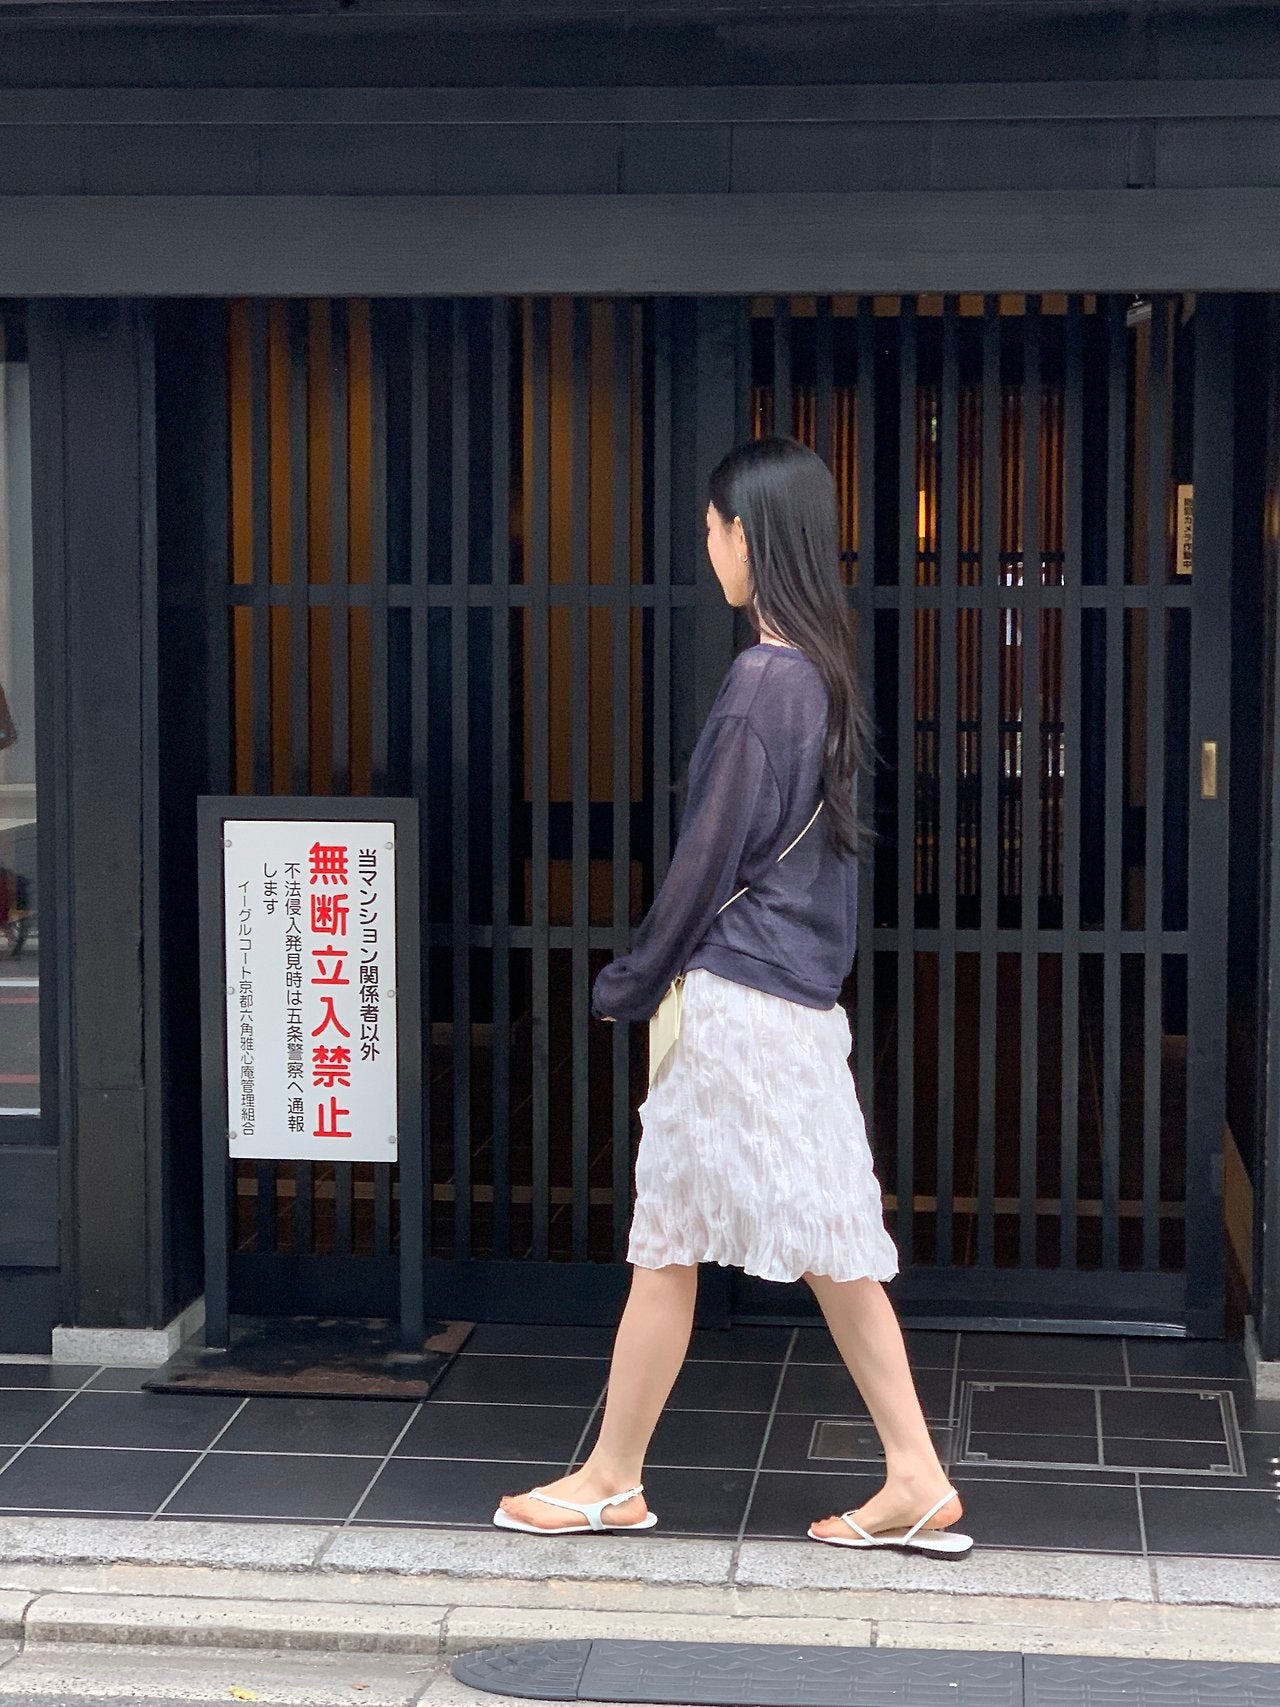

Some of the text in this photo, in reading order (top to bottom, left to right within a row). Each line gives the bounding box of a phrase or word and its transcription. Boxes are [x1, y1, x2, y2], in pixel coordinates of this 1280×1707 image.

[263, 862, 278, 915] します
[284, 862, 305, 1132] 不法侵入発見時は五条警察へ通報
[308, 841, 352, 1137] 無断立入禁止
[358, 848, 380, 1061] 当マンション関係者以外
